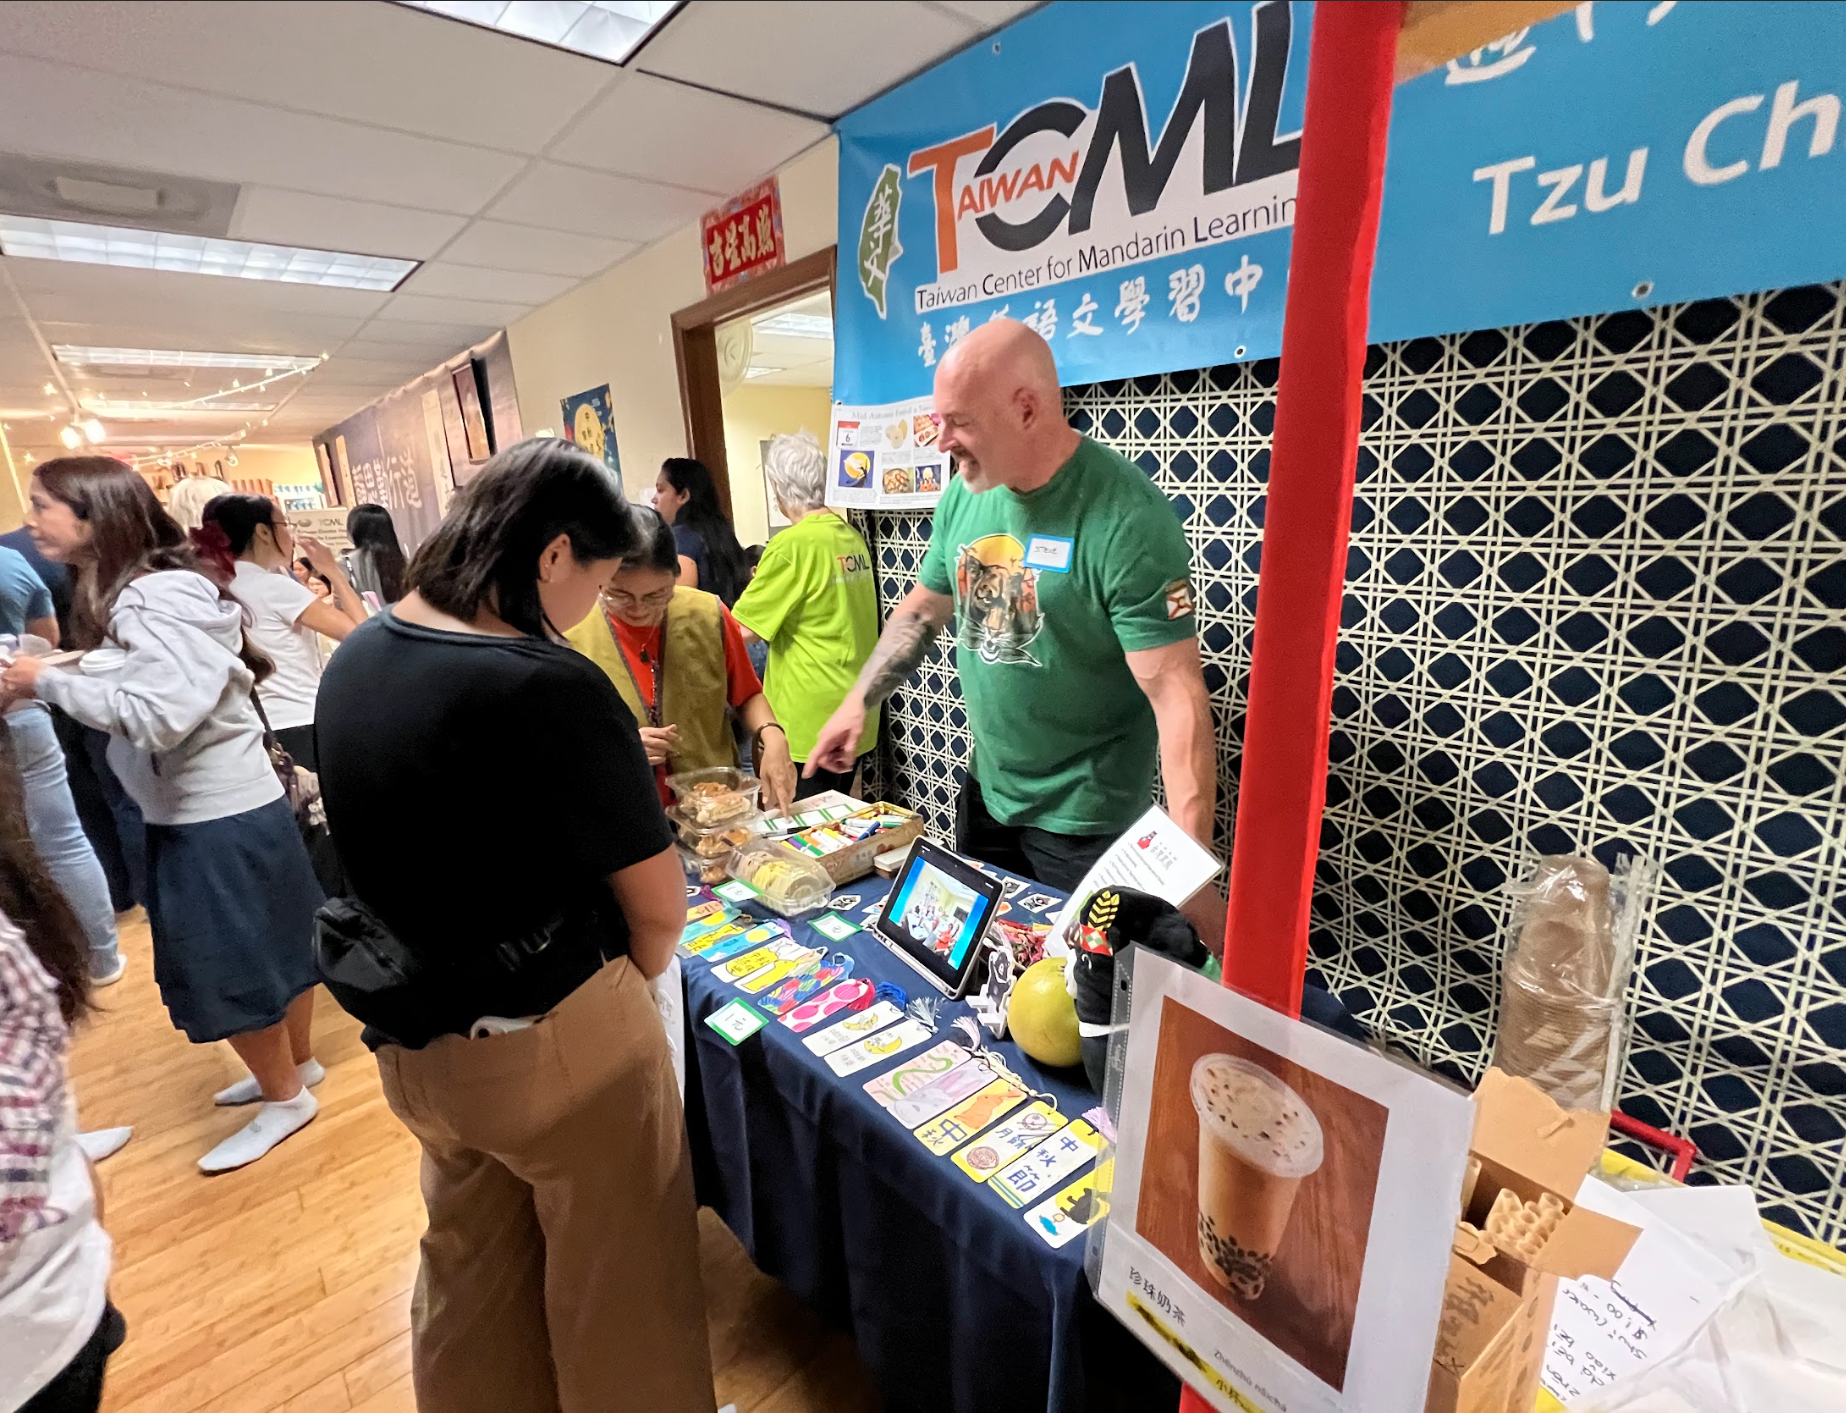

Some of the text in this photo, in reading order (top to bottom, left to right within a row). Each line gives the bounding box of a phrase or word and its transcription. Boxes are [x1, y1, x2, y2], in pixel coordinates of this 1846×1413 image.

[908, 1, 1301, 274] TCML
[1473, 80, 1842, 235] Tzu Ch
[858, 184, 893, 287] 華文
[916, 195, 1297, 309] Taiwan Center for Mandarin Learnin
[845, 433, 851, 443] 6
[837, 554, 870, 574] TCML
[921, 1118, 968, 1147] 中秋
[1006, 1136, 1079, 1193] 中秋節
[1128, 1266, 1186, 1327] 珍珠奶茶
